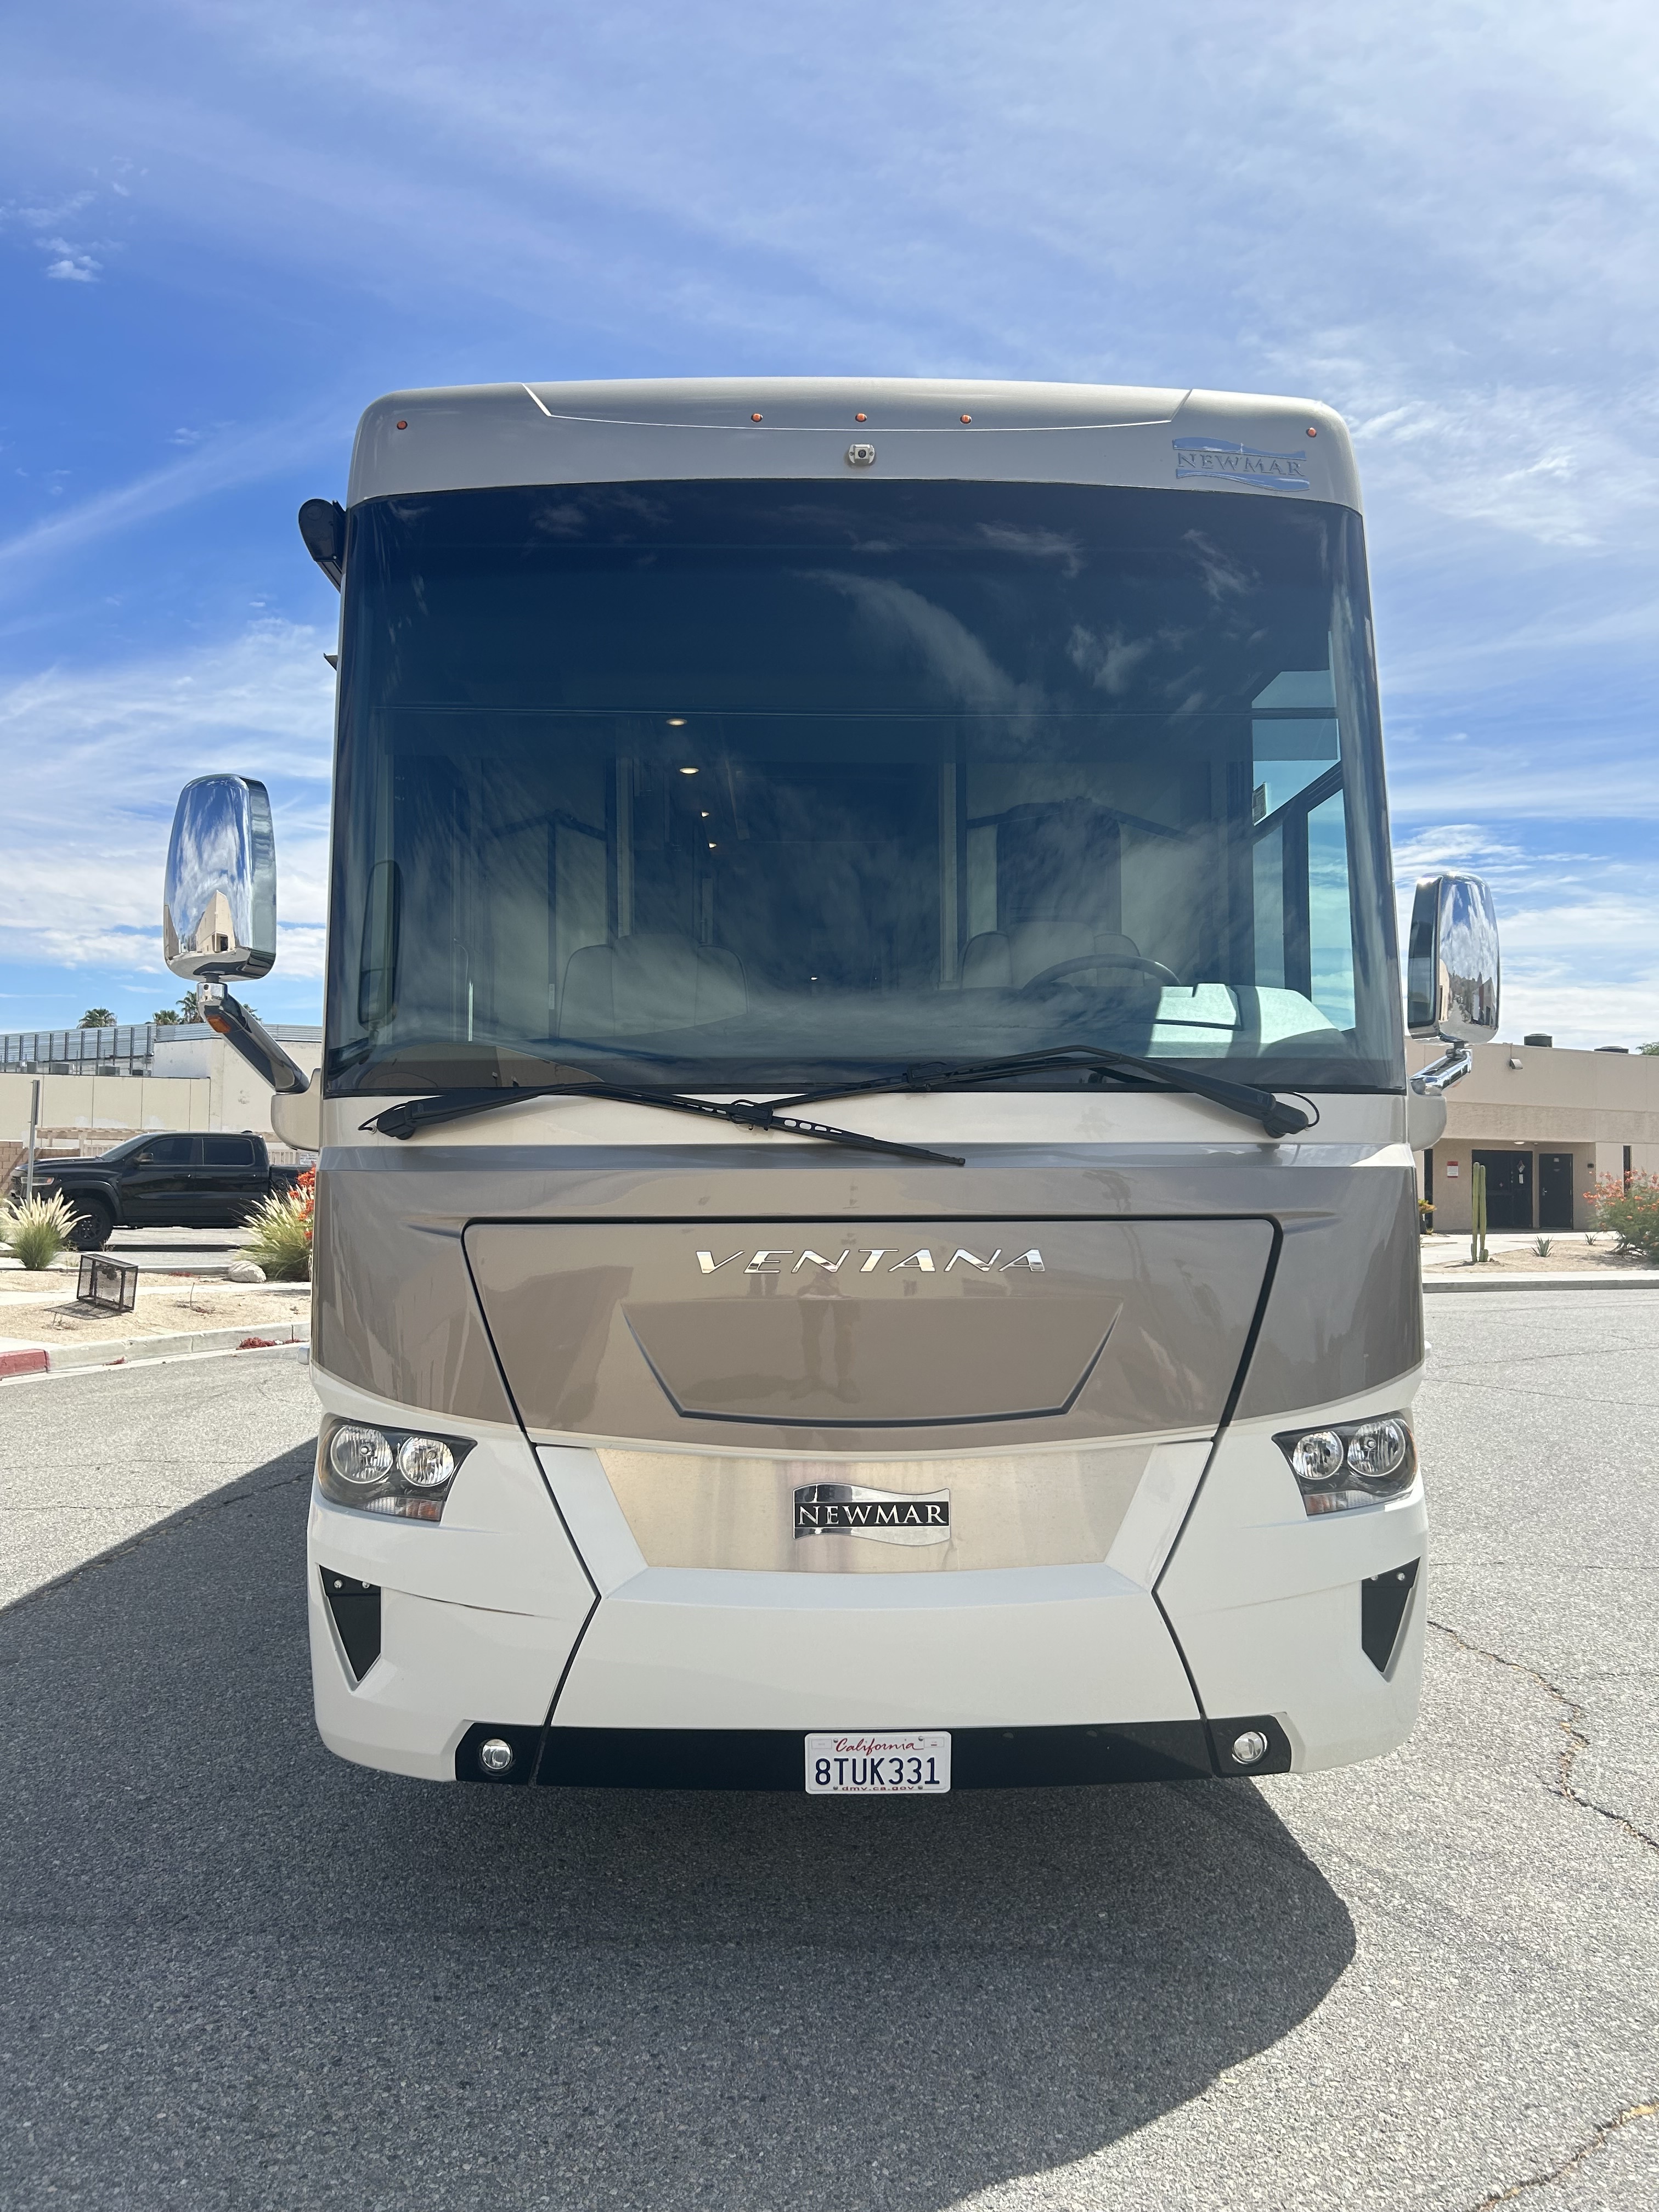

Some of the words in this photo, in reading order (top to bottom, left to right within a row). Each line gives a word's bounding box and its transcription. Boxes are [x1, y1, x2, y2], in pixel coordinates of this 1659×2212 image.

[1178, 453, 1306, 477] NEWMAR
[696, 1248, 1045, 1274] VENTANA
[798, 1504, 947, 1525] NEWMAR
[836, 1738, 924, 1756] California
[815, 1757, 940, 1785] 8TUK331
